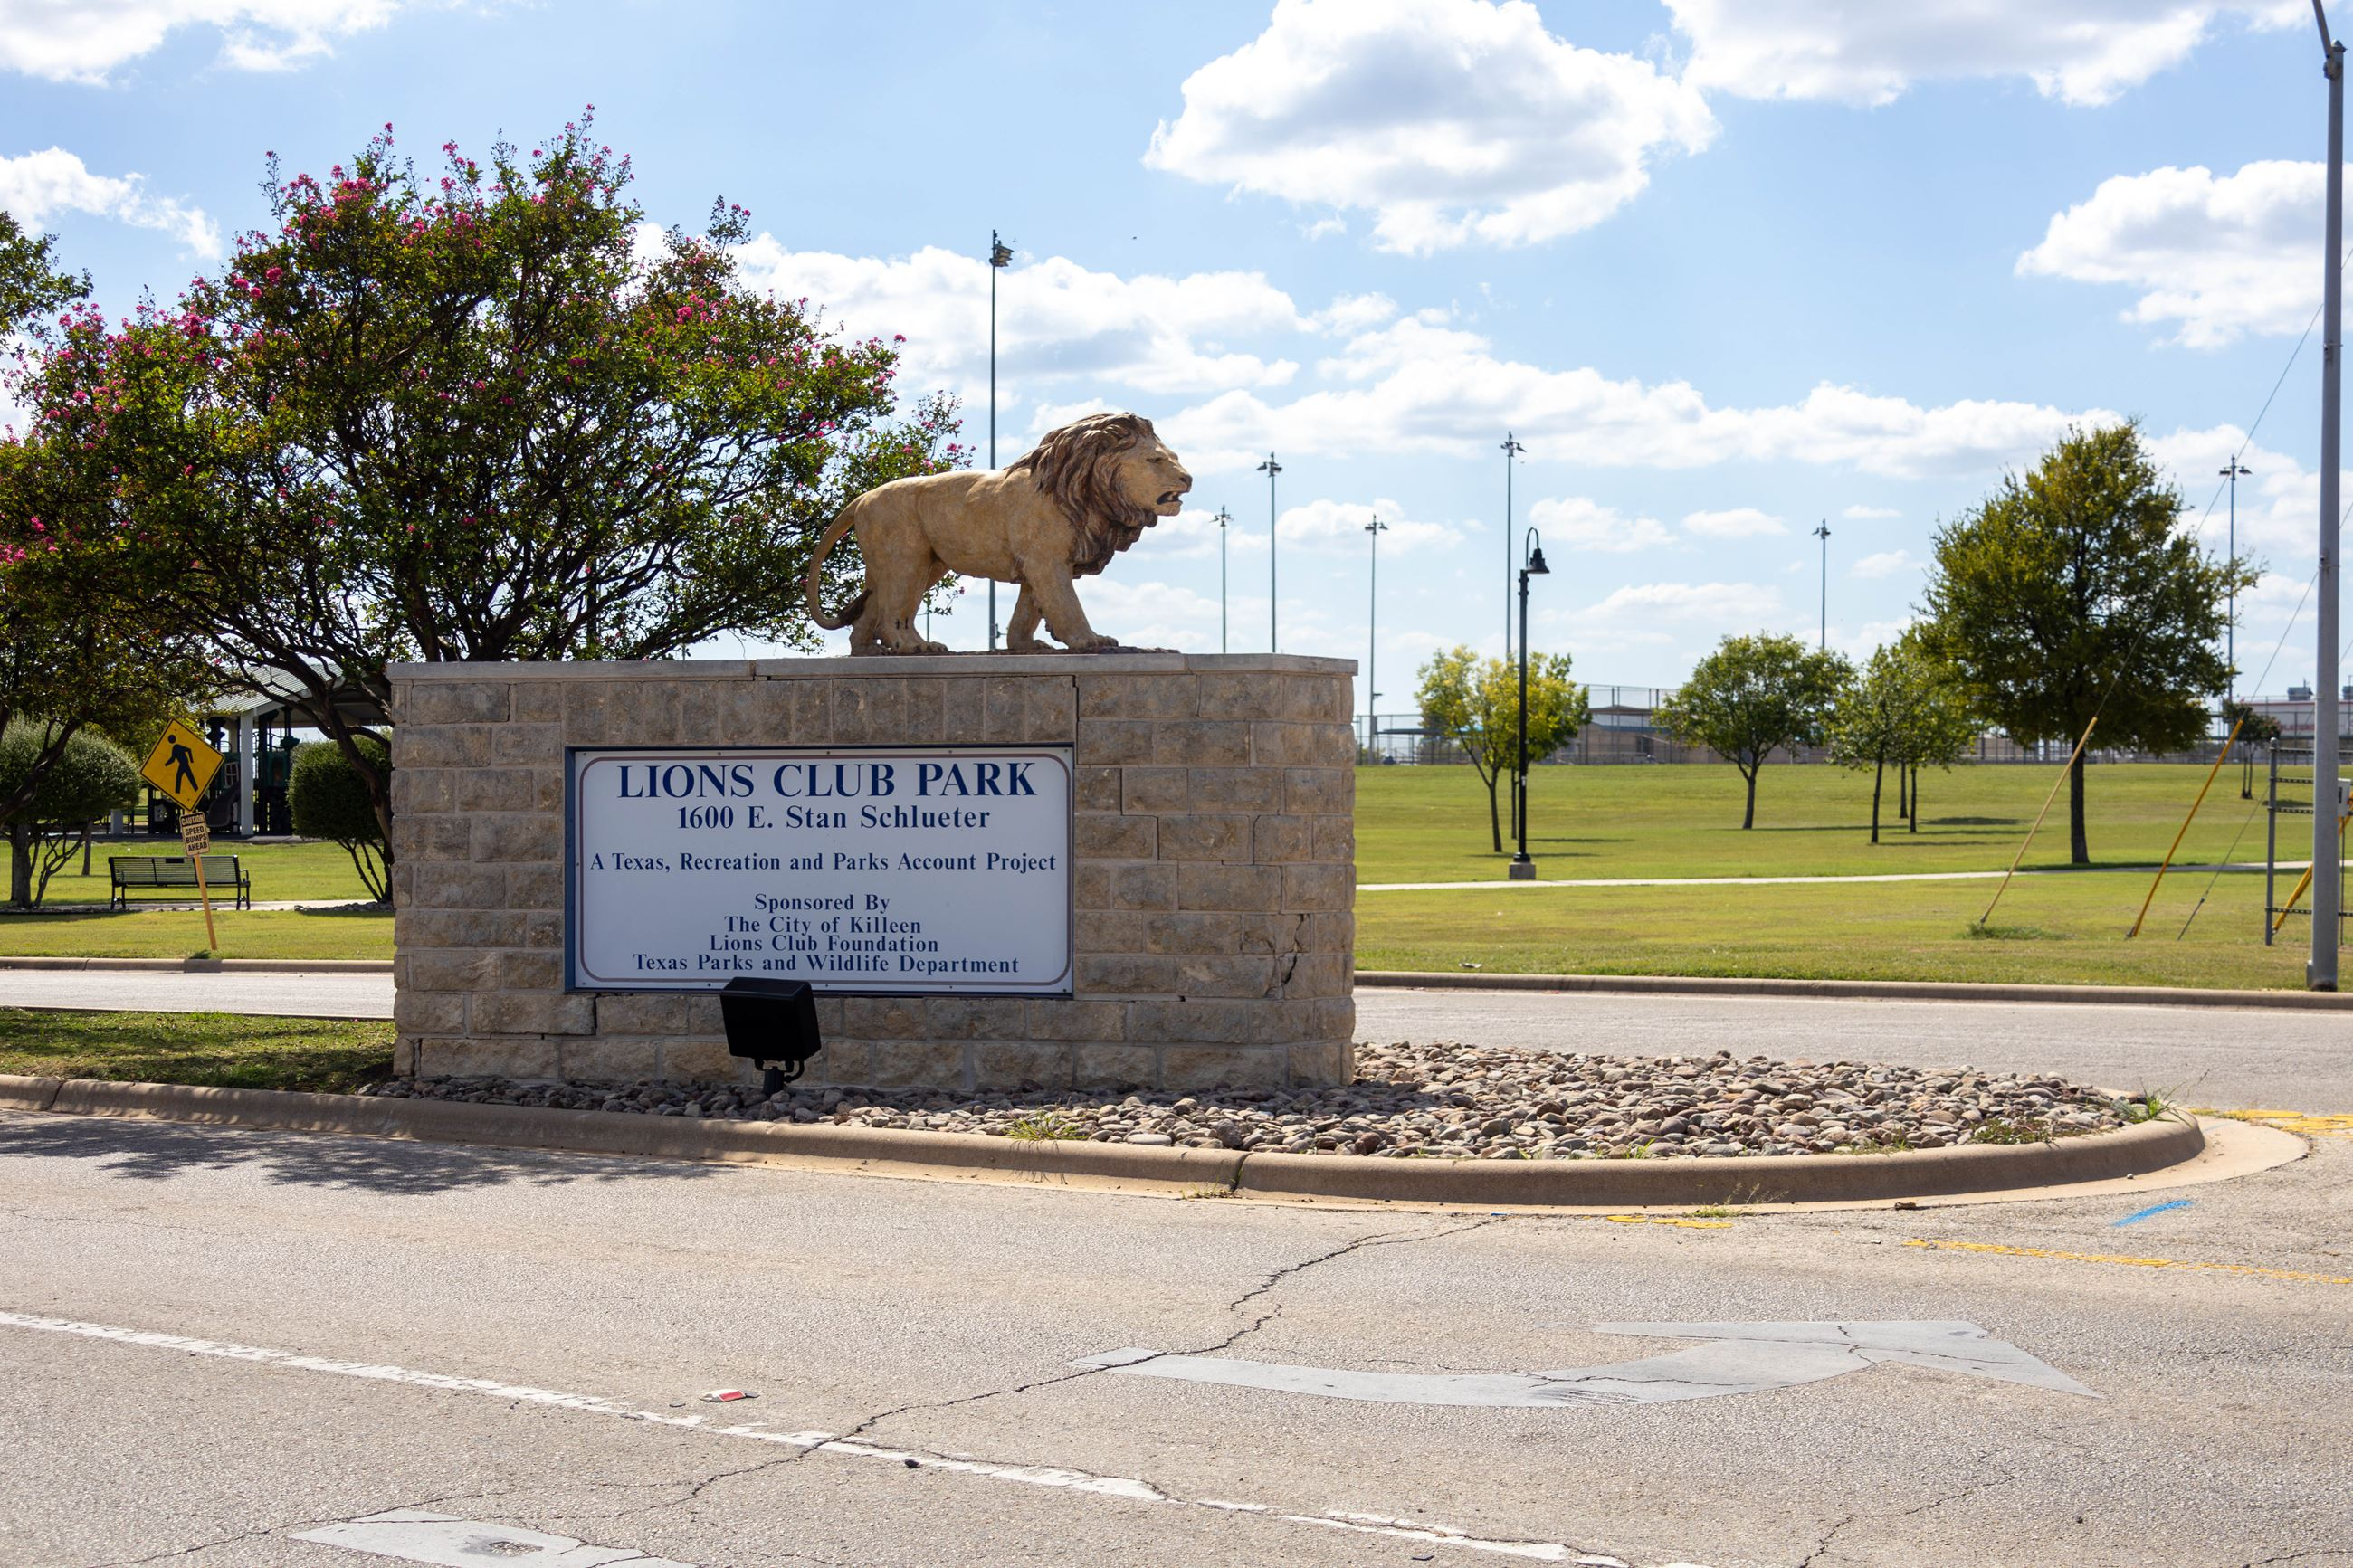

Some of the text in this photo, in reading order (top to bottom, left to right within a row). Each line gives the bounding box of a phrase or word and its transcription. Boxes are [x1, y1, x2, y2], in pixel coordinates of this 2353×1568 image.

[617, 763, 1038, 799] LIONS CLUB PARK
[181, 814, 205, 825] CAUTION
[678, 804, 991, 830] 1600 E. Stan Schlueter
[185, 825, 205, 836] SPEED
[186, 832, 207, 844] BUMPS
[187, 841, 207, 851] AHEAD
[591, 852, 1057, 875] A Texas, Recreation and Parks Account Project
[755, 892, 891, 915] Sponsored By
[724, 916, 921, 936] The City of Killeen
[710, 935, 938, 953] Lions Club Foundation
[634, 954, 1019, 976] Texas Parks and Wildlife Department
